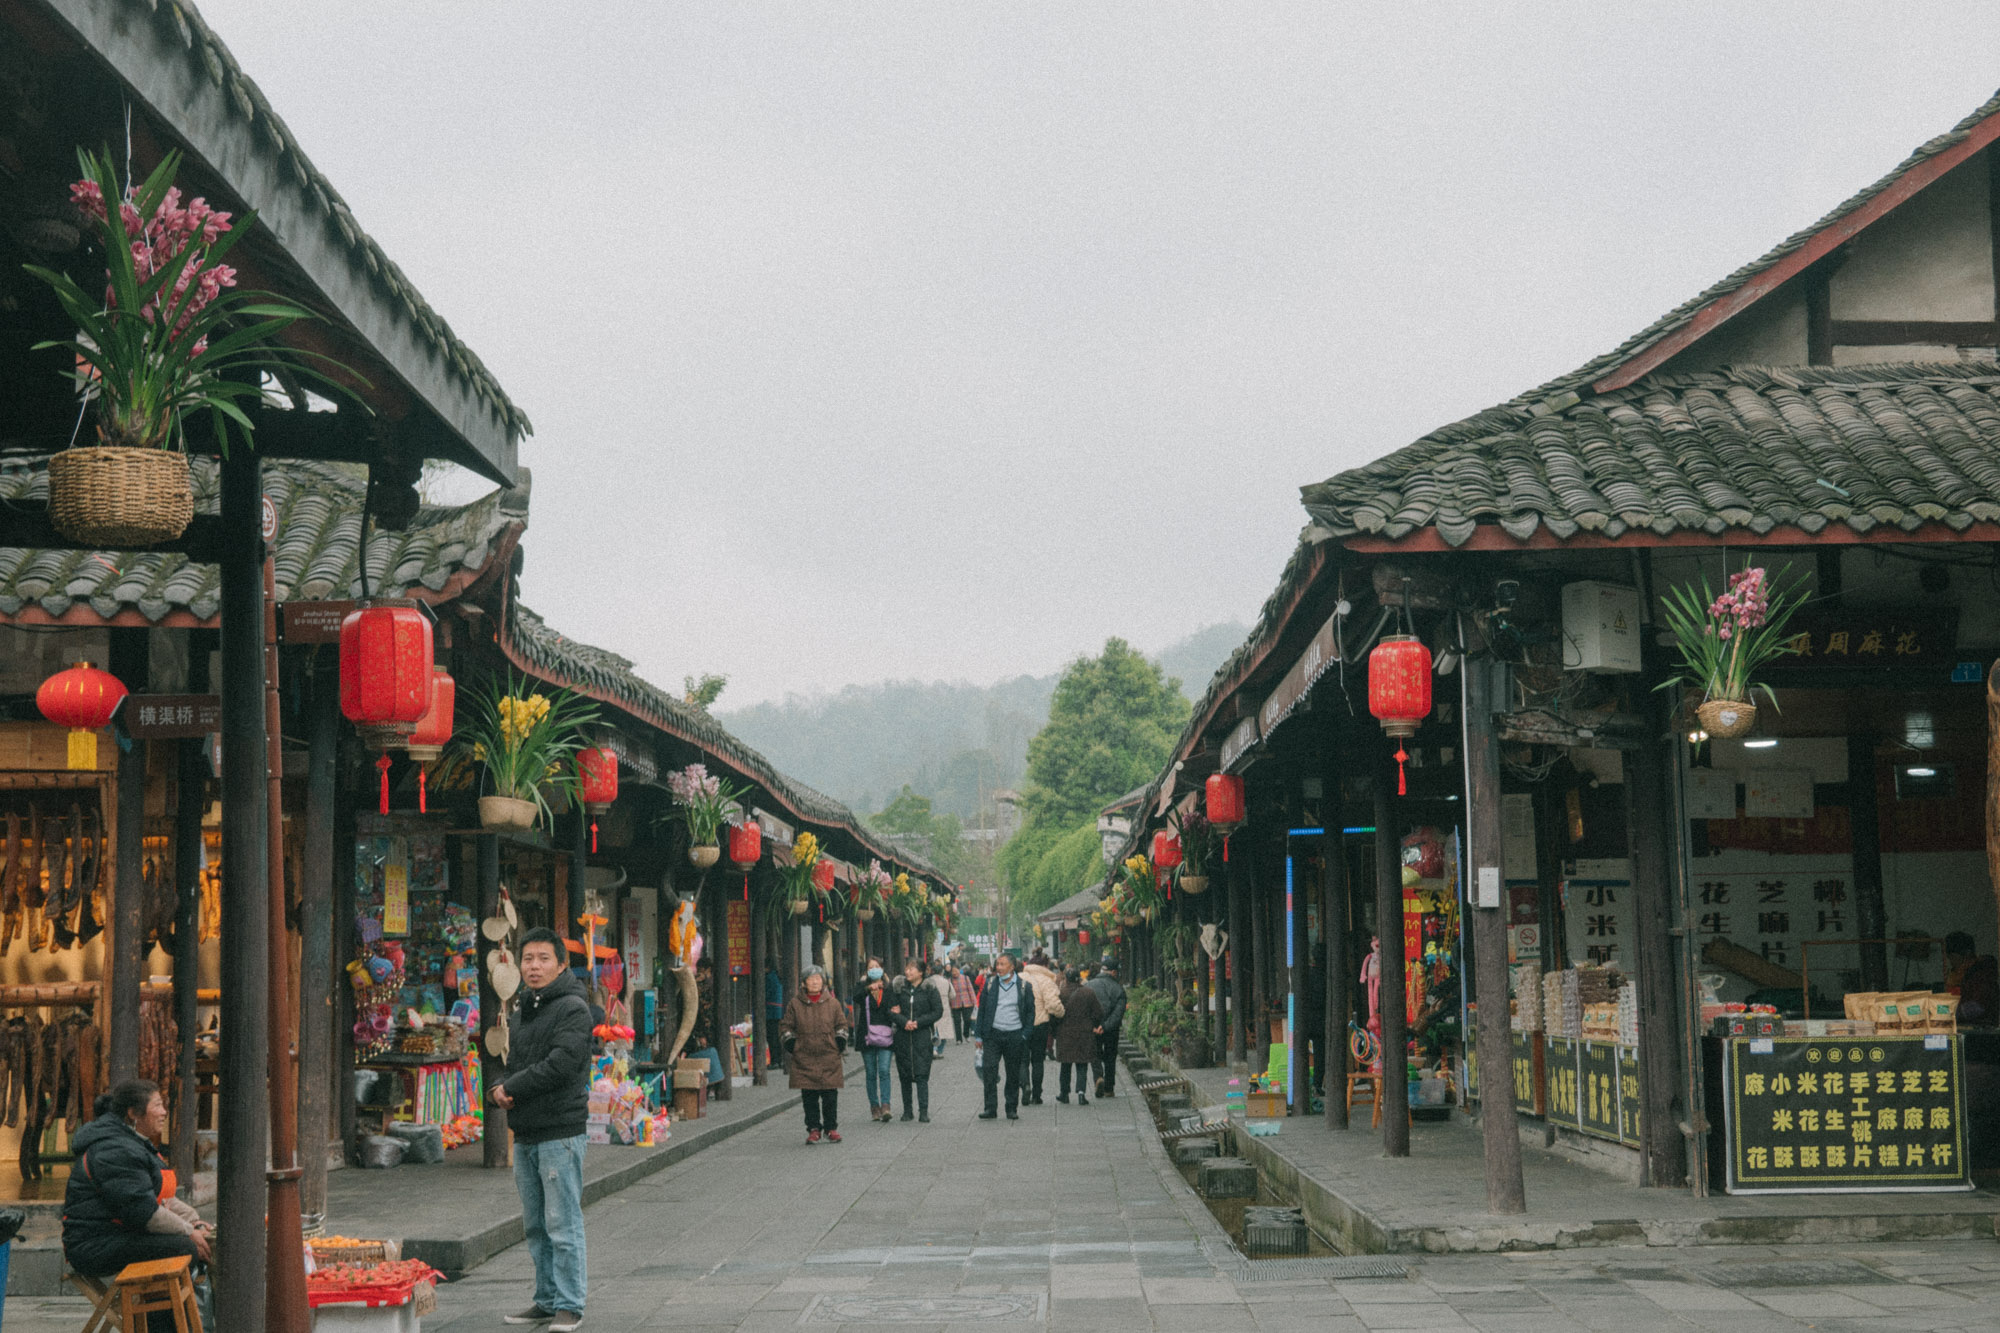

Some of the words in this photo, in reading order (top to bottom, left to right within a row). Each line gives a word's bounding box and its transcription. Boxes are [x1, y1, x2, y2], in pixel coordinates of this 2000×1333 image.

[139, 705, 193, 726] 横渠桥
[1755, 880, 1791, 965] 芝麻片
[1806, 1047, 1885, 1063] 欢迎品尝
[1745, 1072, 1768, 1169] 麻花
[1771, 1073, 1794, 1169] 小米酥
[1797, 1072, 1820, 1168] 米花酥
[1823, 1072, 1846, 1168] 花生酥
[1849, 1071, 1873, 1168] 手工桃片
[1875, 1071, 1900, 1168] 芝麻糕
[1901, 1070, 1926, 1167] 芝麻片
